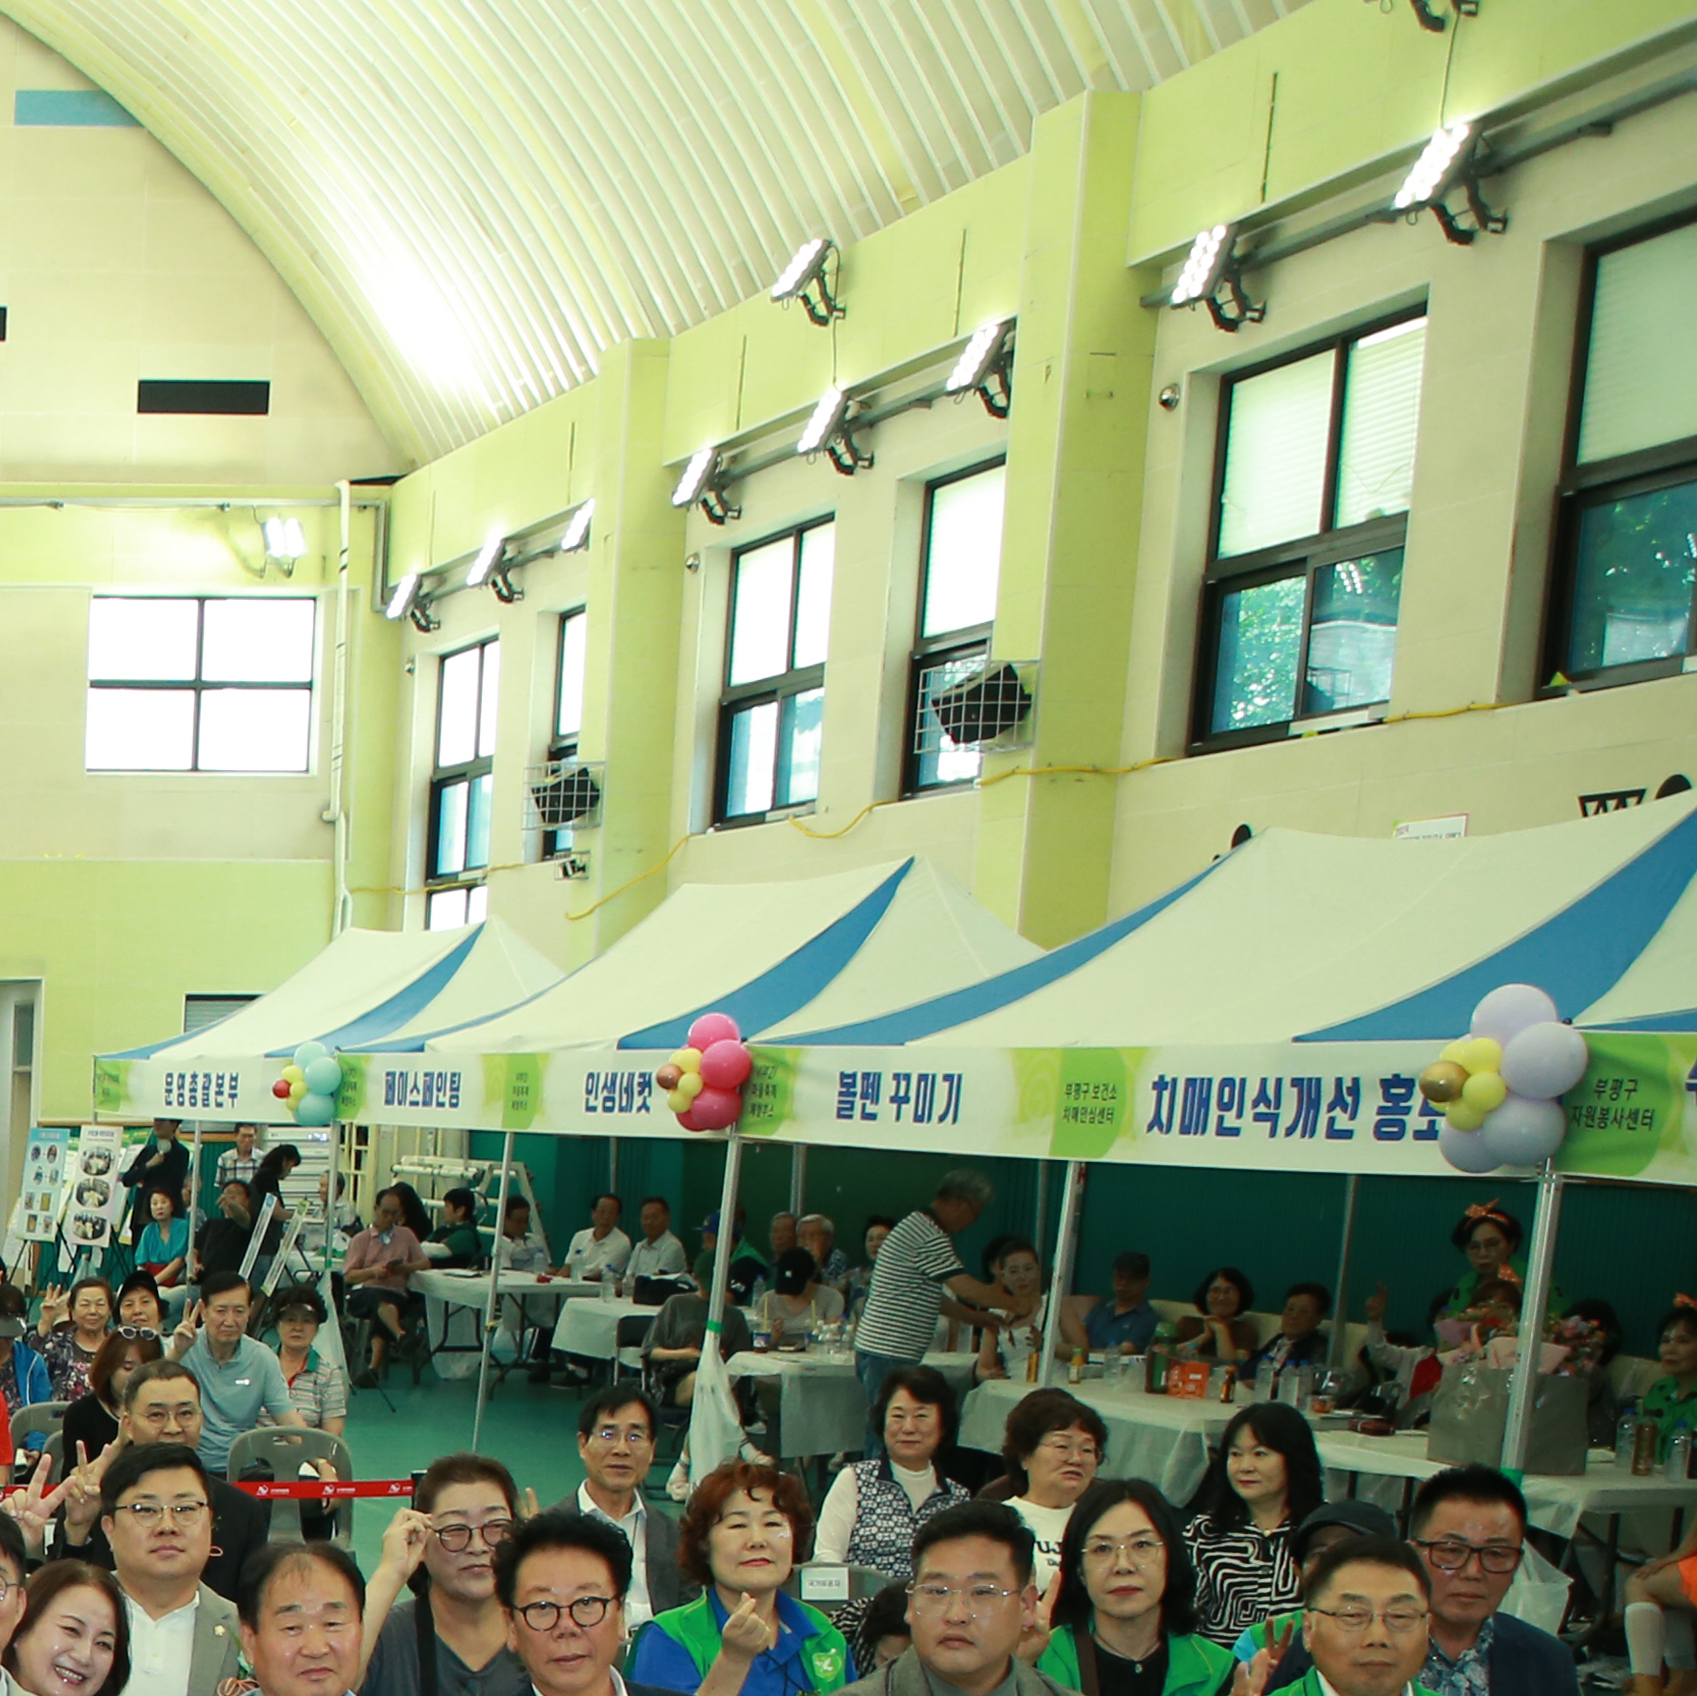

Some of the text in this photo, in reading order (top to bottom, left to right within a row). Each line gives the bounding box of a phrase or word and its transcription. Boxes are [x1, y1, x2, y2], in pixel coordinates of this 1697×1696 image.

[164, 1071, 240, 1109] 운영총괄본부
[383, 1070, 462, 1110] 페이스페인팅
[583, 1070, 653, 1114] 인생네컷
[835, 1070, 964, 1126] 볼펜 꾸미기
[1064, 1081, 1118, 1102] 부평구 보건소
[1145, 1074, 1362, 1142] 치매인식개선
[1593, 1077, 1639, 1102] 부평구
[1062, 1104, 1116, 1126] 치매안심센터
[1570, 1104, 1656, 1132] 자원봉사센터
